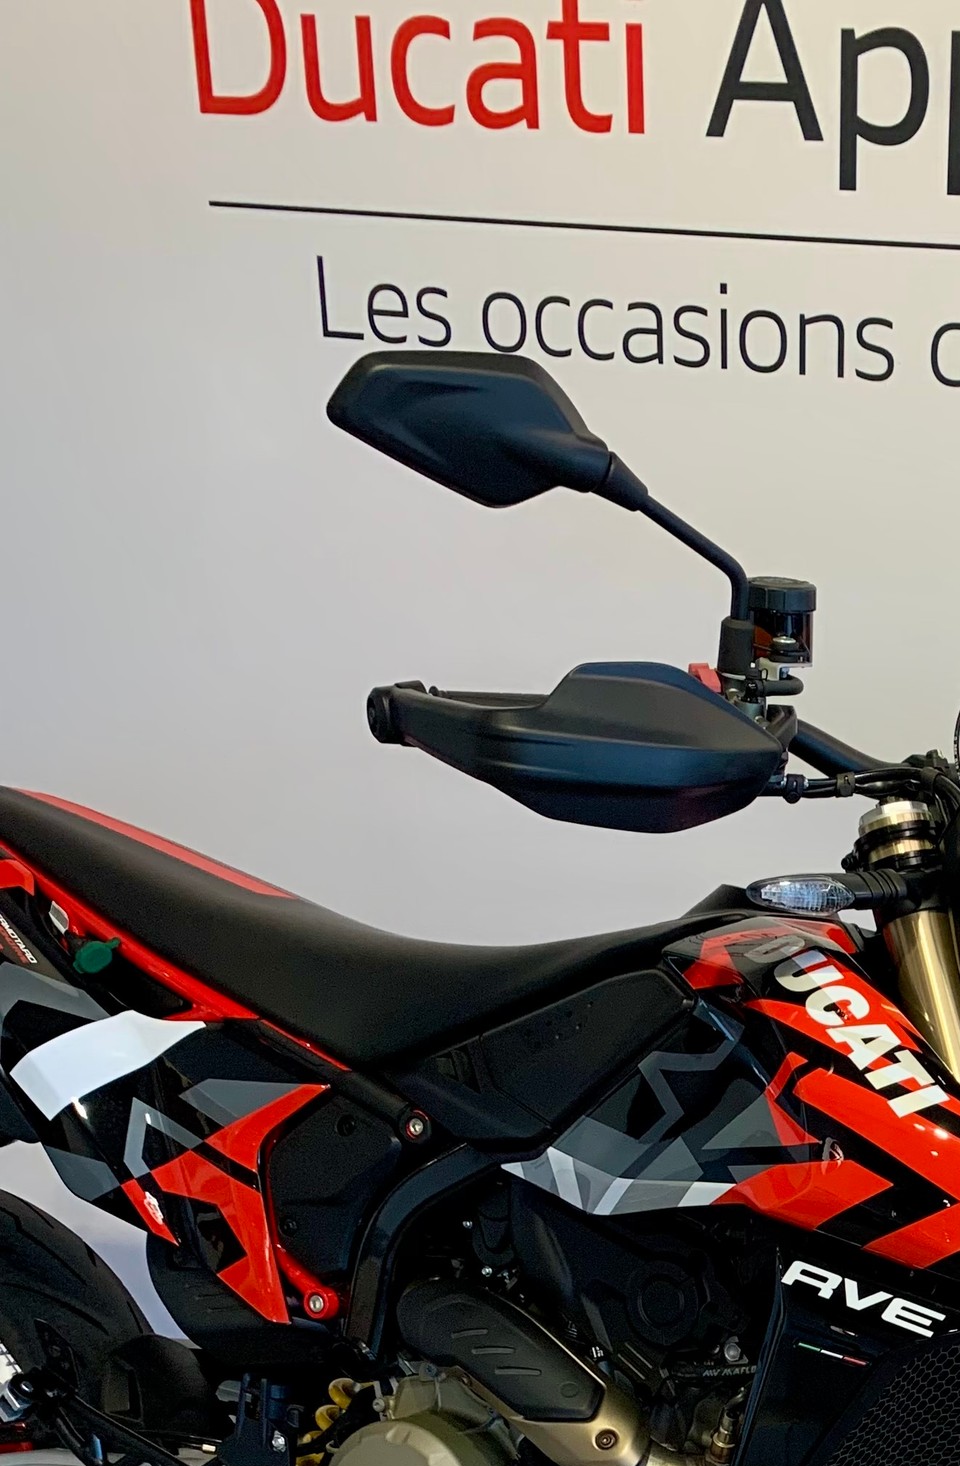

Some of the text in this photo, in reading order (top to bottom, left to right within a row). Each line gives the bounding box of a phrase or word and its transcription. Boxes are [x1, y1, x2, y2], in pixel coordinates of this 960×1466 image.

[189, 0, 646, 135] Ducati
[316, 255, 452, 347] Les
[481, 283, 895, 382] occasions
[744, 935, 951, 1119] DUCATI
[780, 1259, 947, 1339] RVE
